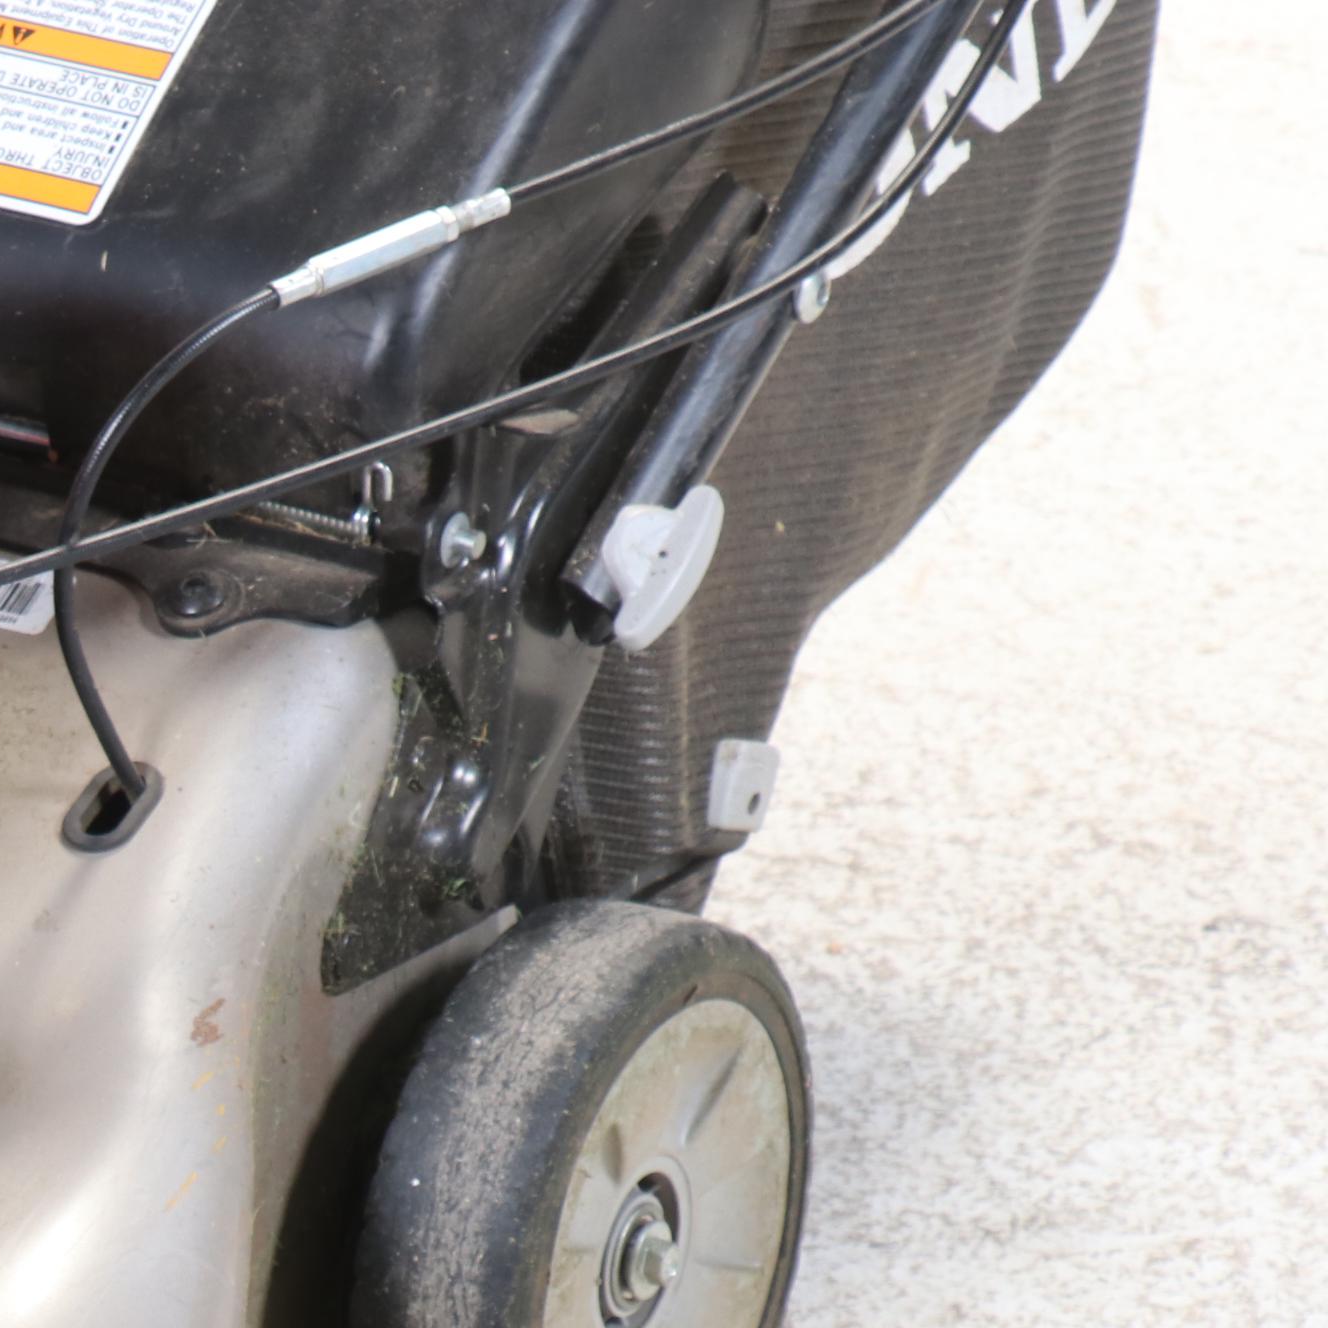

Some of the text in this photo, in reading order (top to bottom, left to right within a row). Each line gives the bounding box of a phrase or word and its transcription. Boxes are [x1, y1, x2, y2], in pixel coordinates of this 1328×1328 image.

[10, 73, 78, 97] OPERATE
[59, 69, 147, 98] IS IN PLACE
[80, 88, 113, 105] NOT
[117, 97, 140, 111] DO
[42, 157, 102, 180] OBJECT
